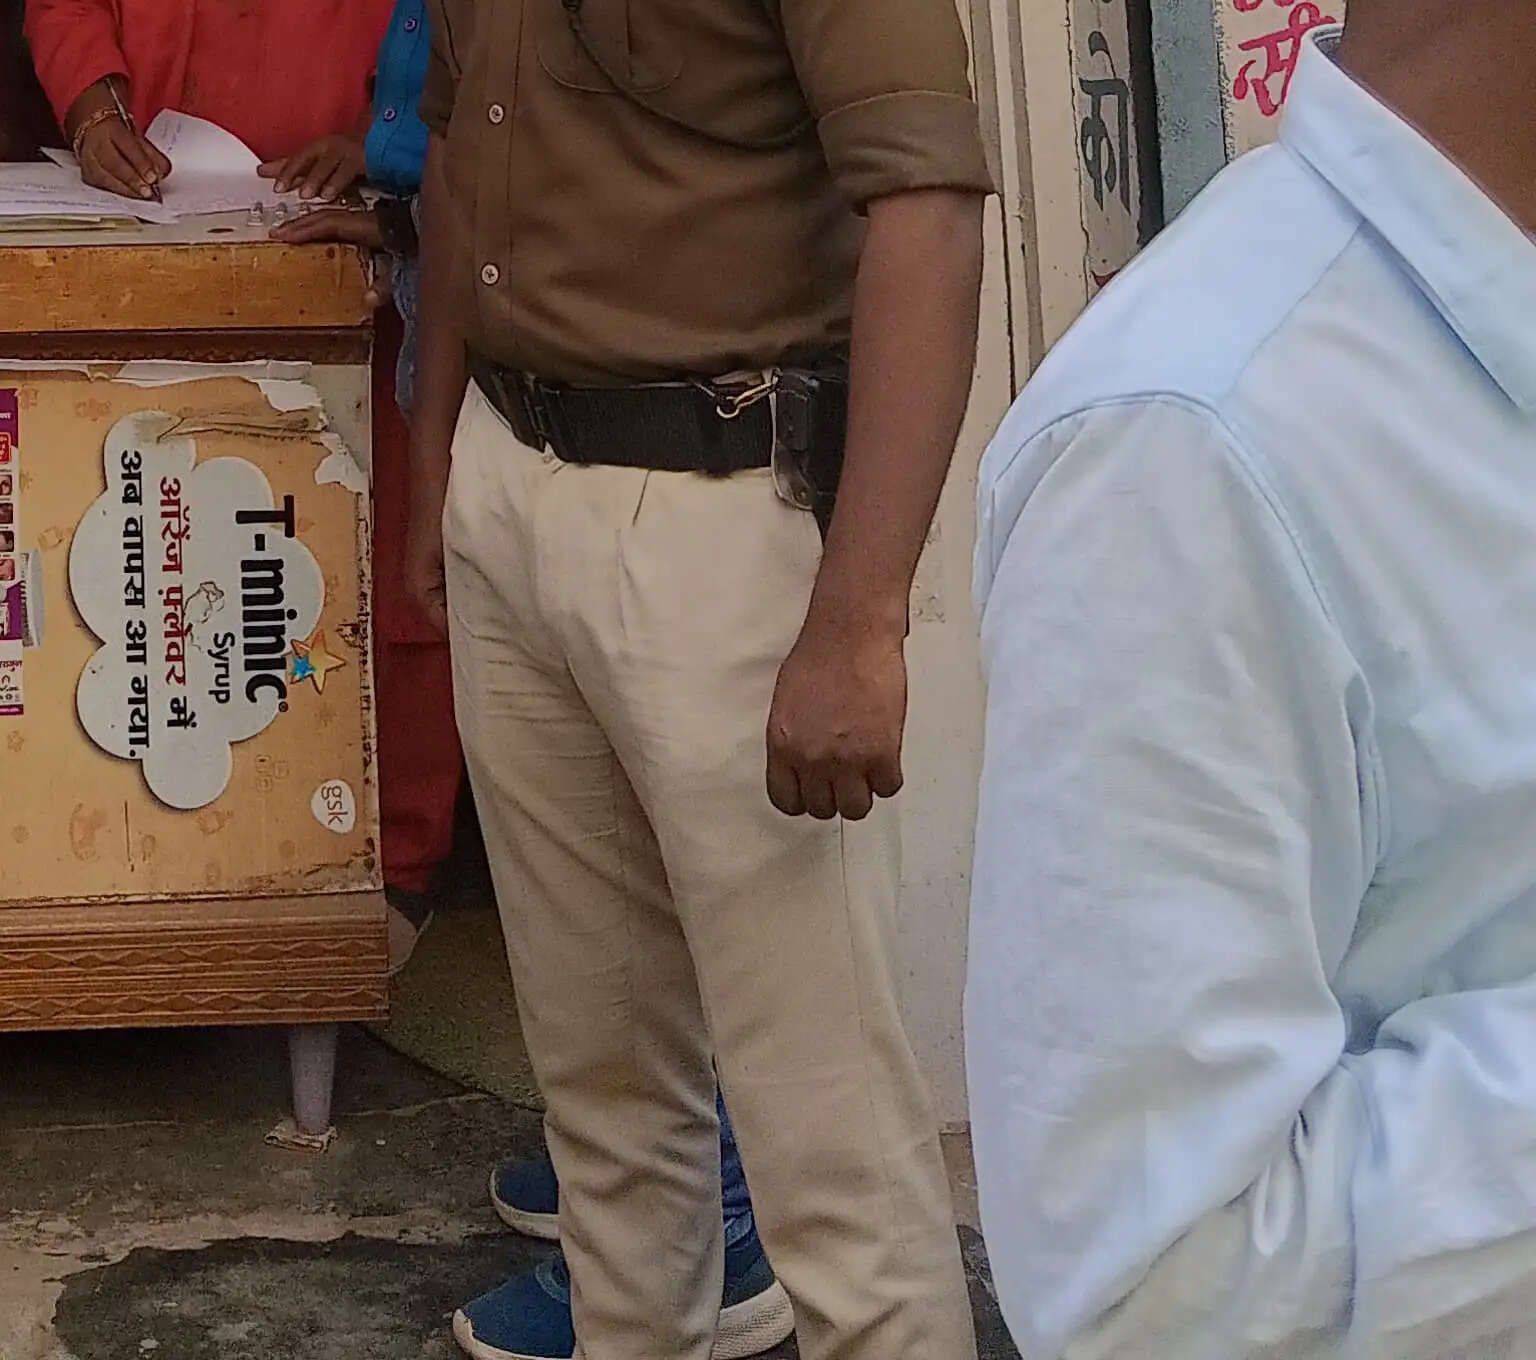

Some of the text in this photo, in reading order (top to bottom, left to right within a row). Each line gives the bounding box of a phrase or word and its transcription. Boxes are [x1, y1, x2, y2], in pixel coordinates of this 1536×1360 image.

[120, 449, 143, 506] अब
[122, 515, 145, 609] वापस
[125, 620, 147, 665] आ
[207, 631, 236, 705] Syrup
[166, 695, 197, 730] में
[320, 784, 345, 826] gsk
